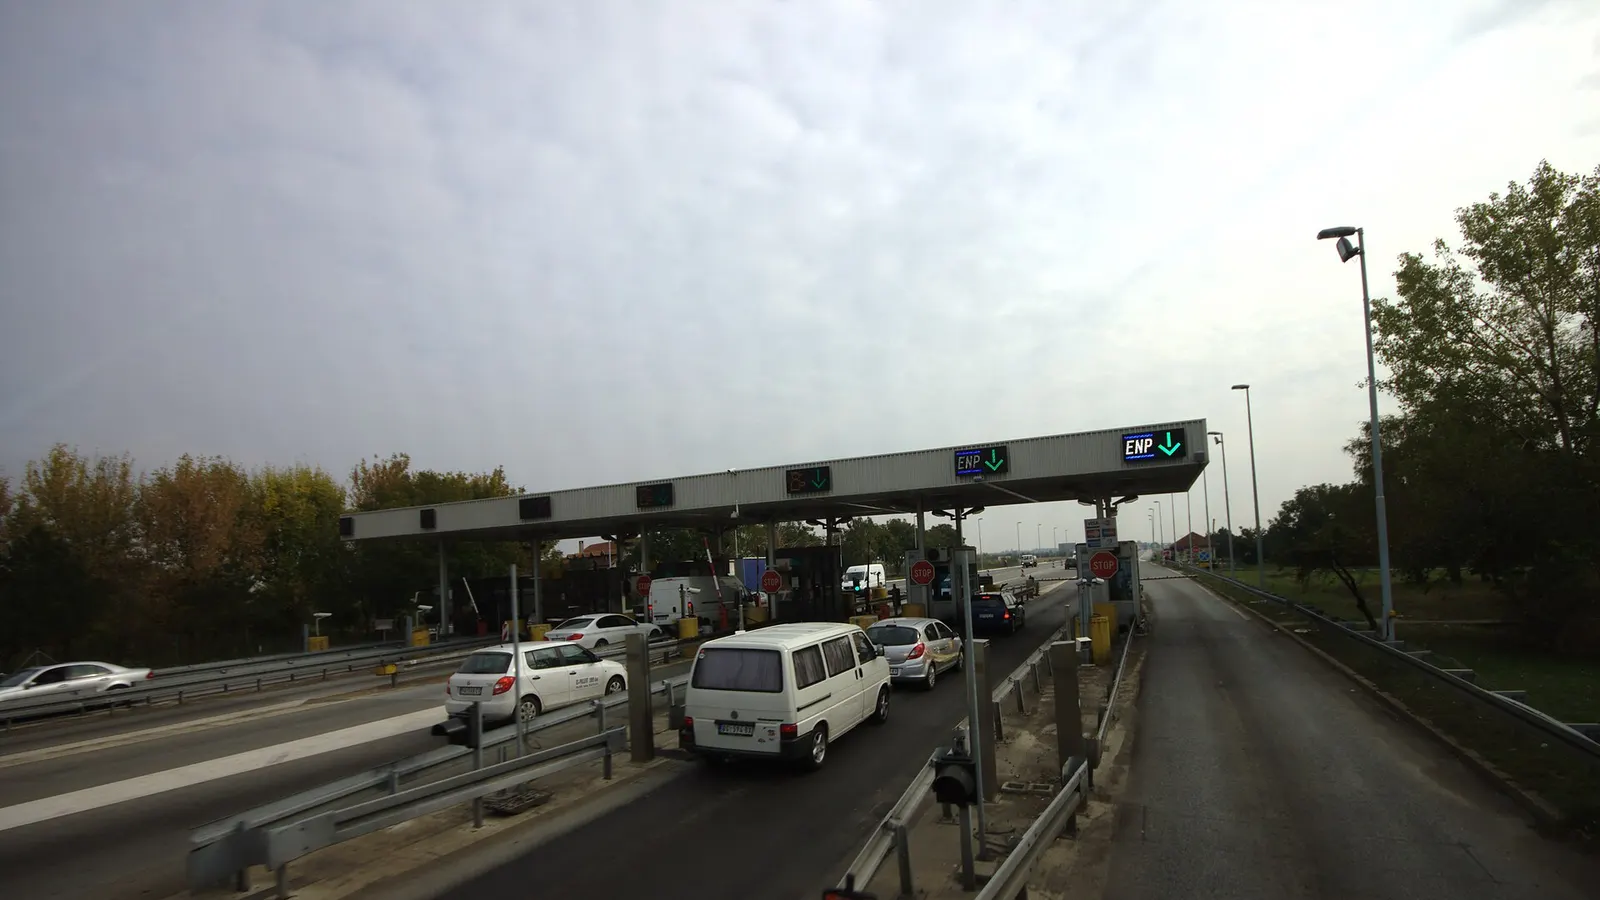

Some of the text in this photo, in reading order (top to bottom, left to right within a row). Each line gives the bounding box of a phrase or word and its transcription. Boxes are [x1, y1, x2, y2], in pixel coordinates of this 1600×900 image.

[1125, 438, 1153, 455] ENP
[957, 454, 981, 470] ENP
[1093, 560, 1115, 570] STOP
[914, 568, 932, 578] STOP
[763, 577, 779, 587] STOP
